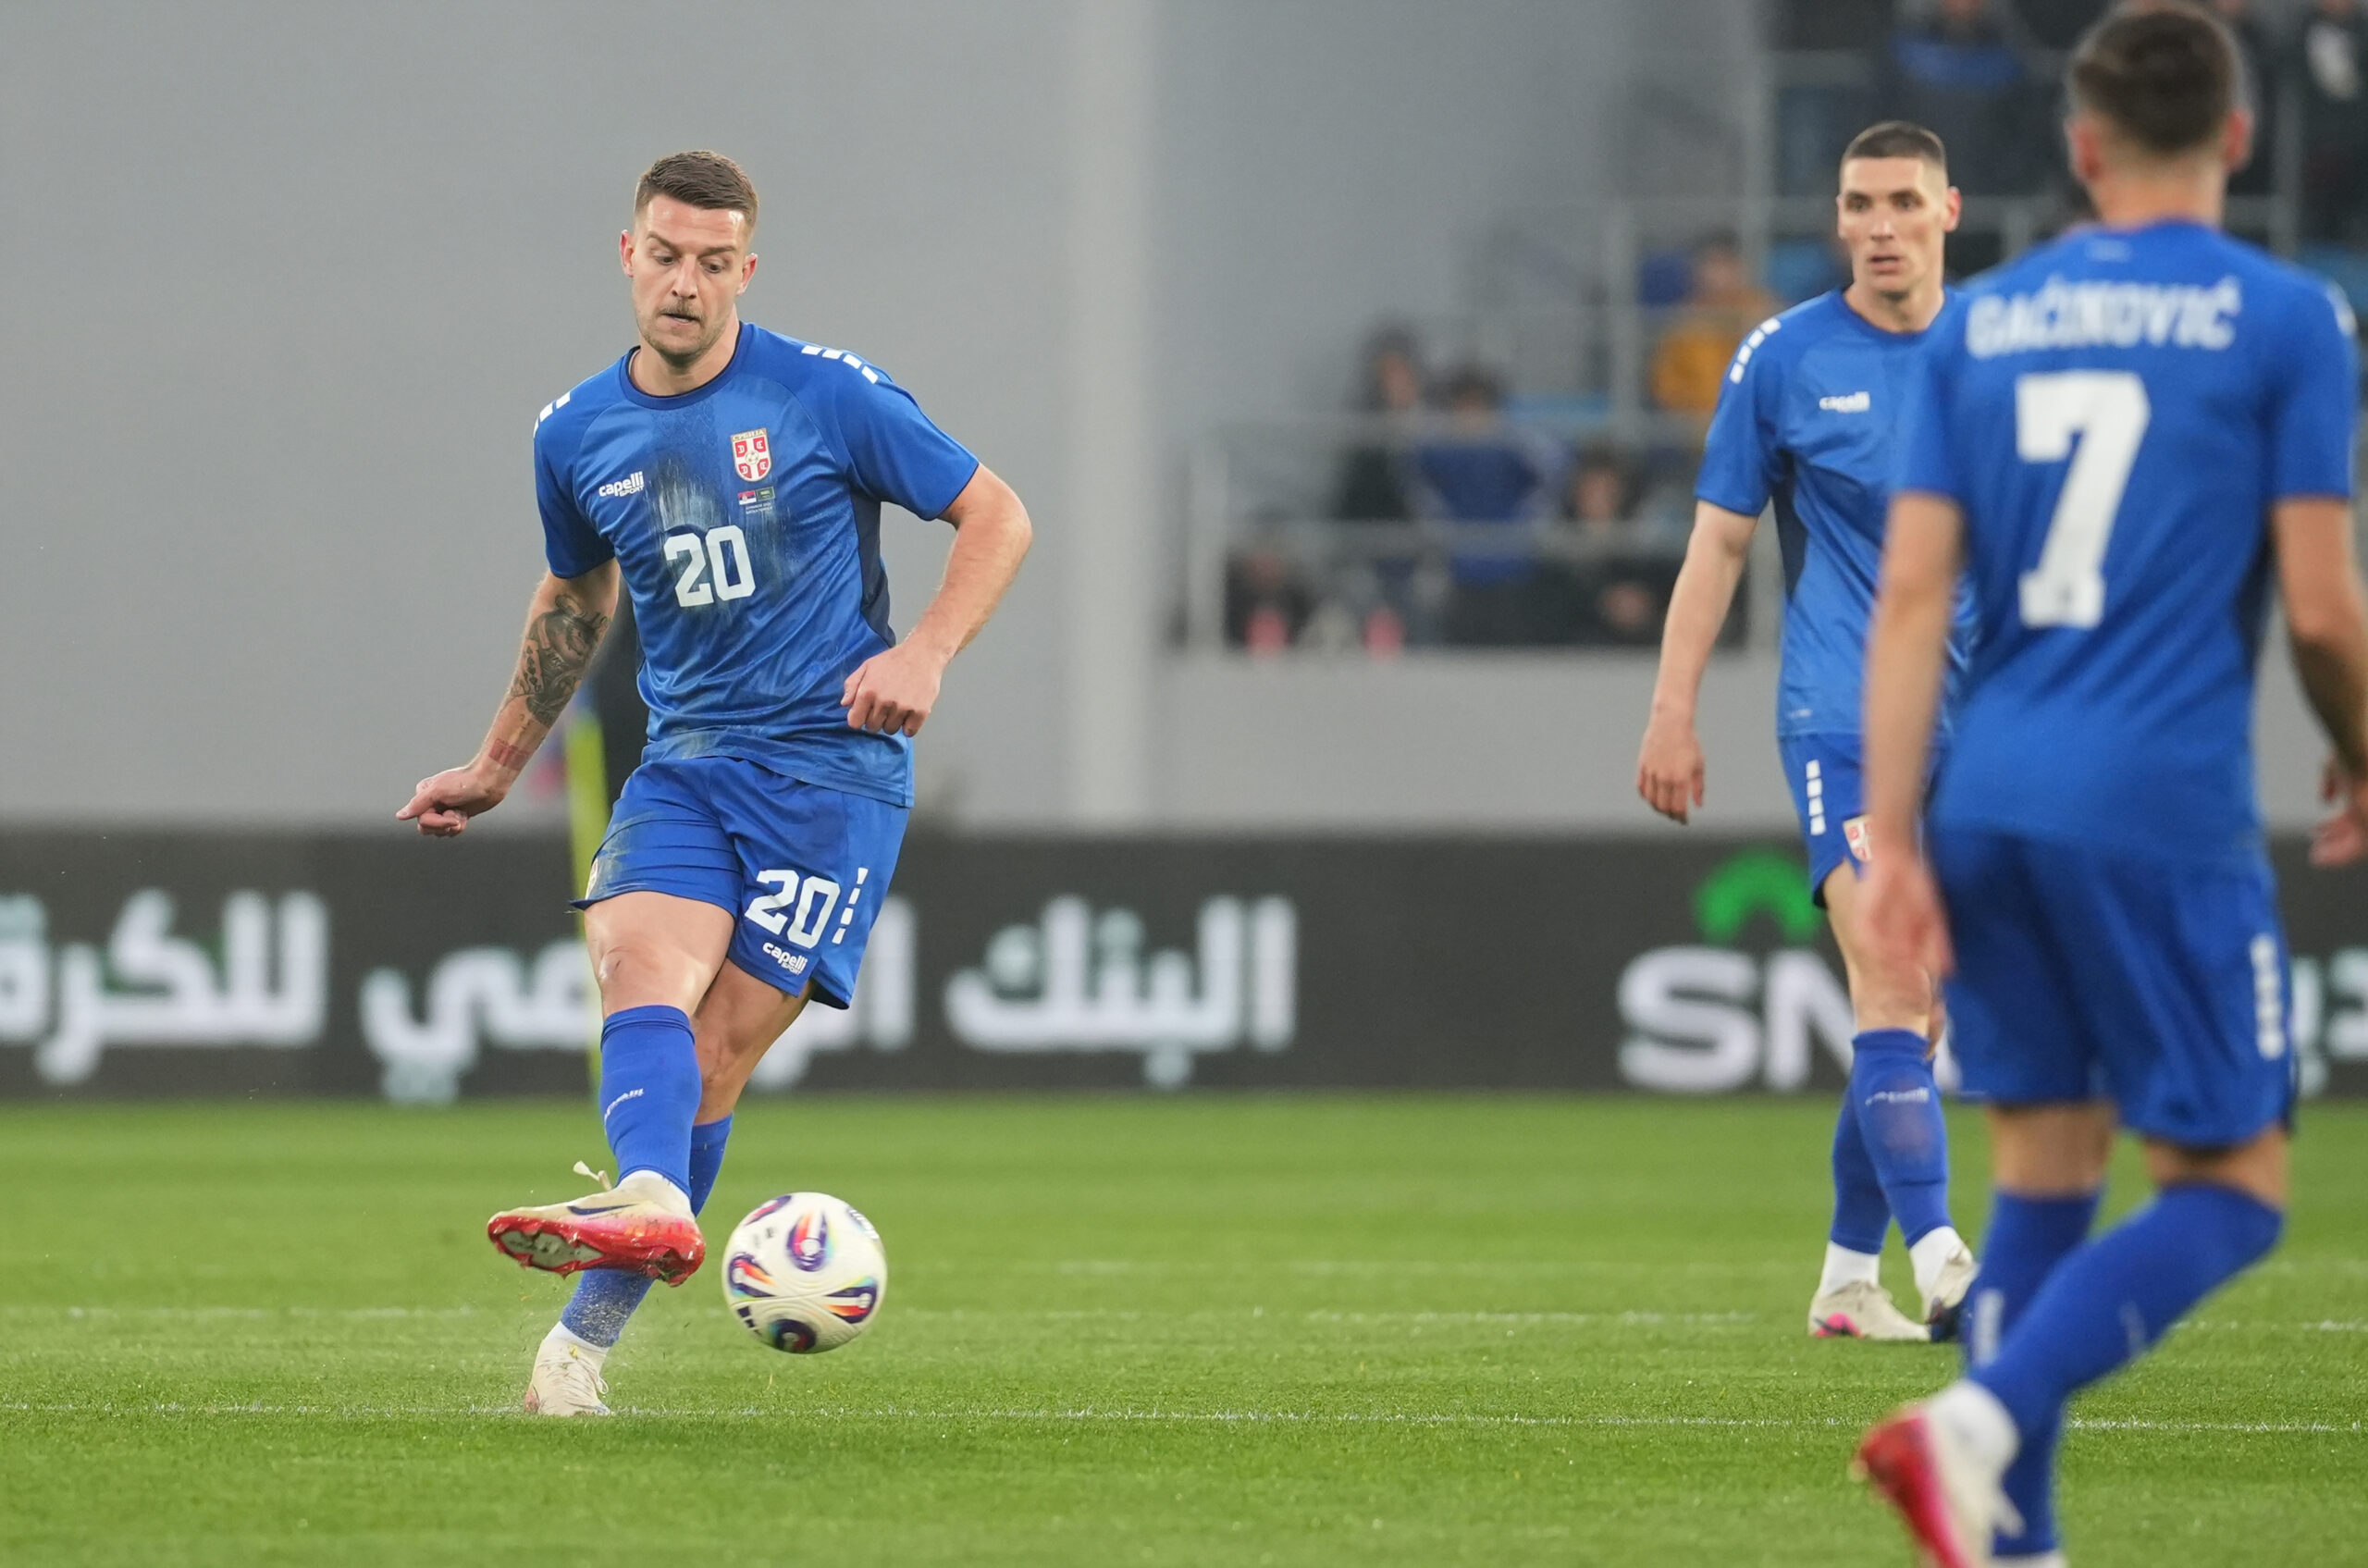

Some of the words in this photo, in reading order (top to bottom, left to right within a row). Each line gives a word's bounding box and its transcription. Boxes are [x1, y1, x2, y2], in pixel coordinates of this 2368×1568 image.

[598, 471, 644, 497] capelli
[2016, 369, 2151, 630] 7
[663, 525, 756, 608] 20
[745, 870, 841, 949] 20
[762, 942, 808, 972] capelli
[945, 897, 1296, 1084] البنك
[1619, 945, 1961, 1093] SN
